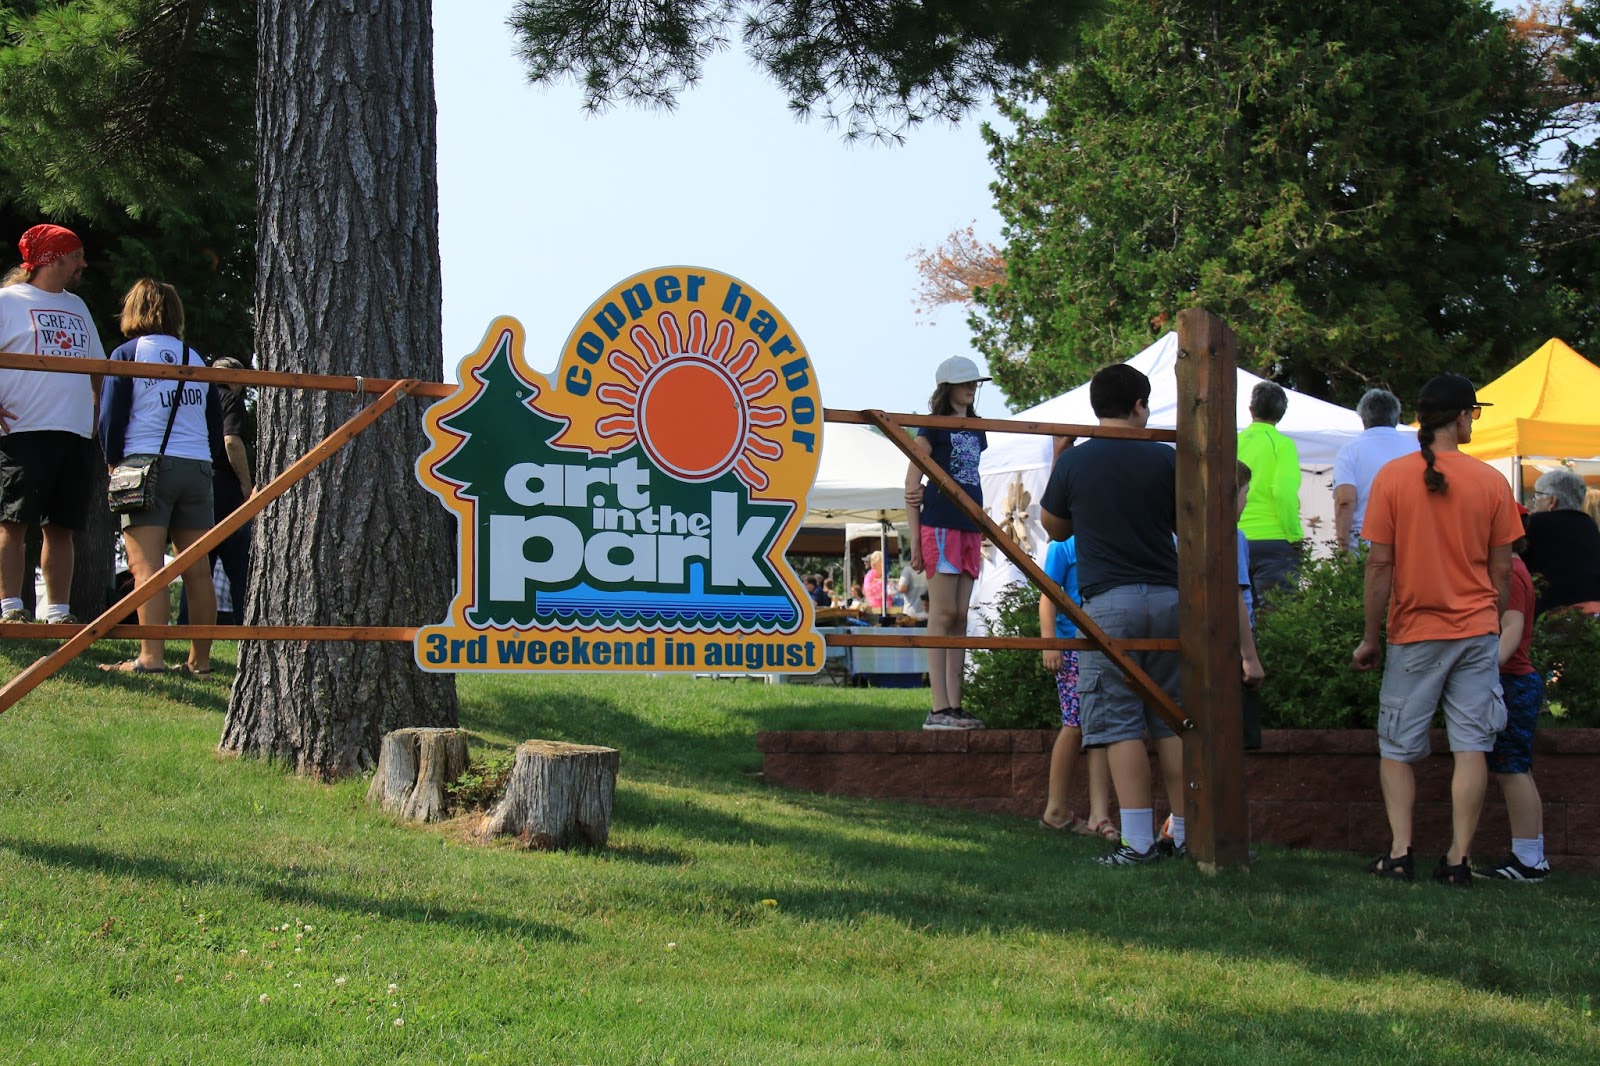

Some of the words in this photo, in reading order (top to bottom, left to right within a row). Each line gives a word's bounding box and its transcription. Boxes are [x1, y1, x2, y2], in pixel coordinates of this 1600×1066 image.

[38, 313, 84, 331] GREAT
[565, 274, 705, 397] copper
[721, 282, 815, 453] harbor
[504, 456, 650, 509] art
[489, 490, 776, 602] park
[426, 633, 488, 664] 3rd
[497, 635, 655, 666] weekend
[664, 637, 696, 666] in
[704, 640, 816, 669] august
